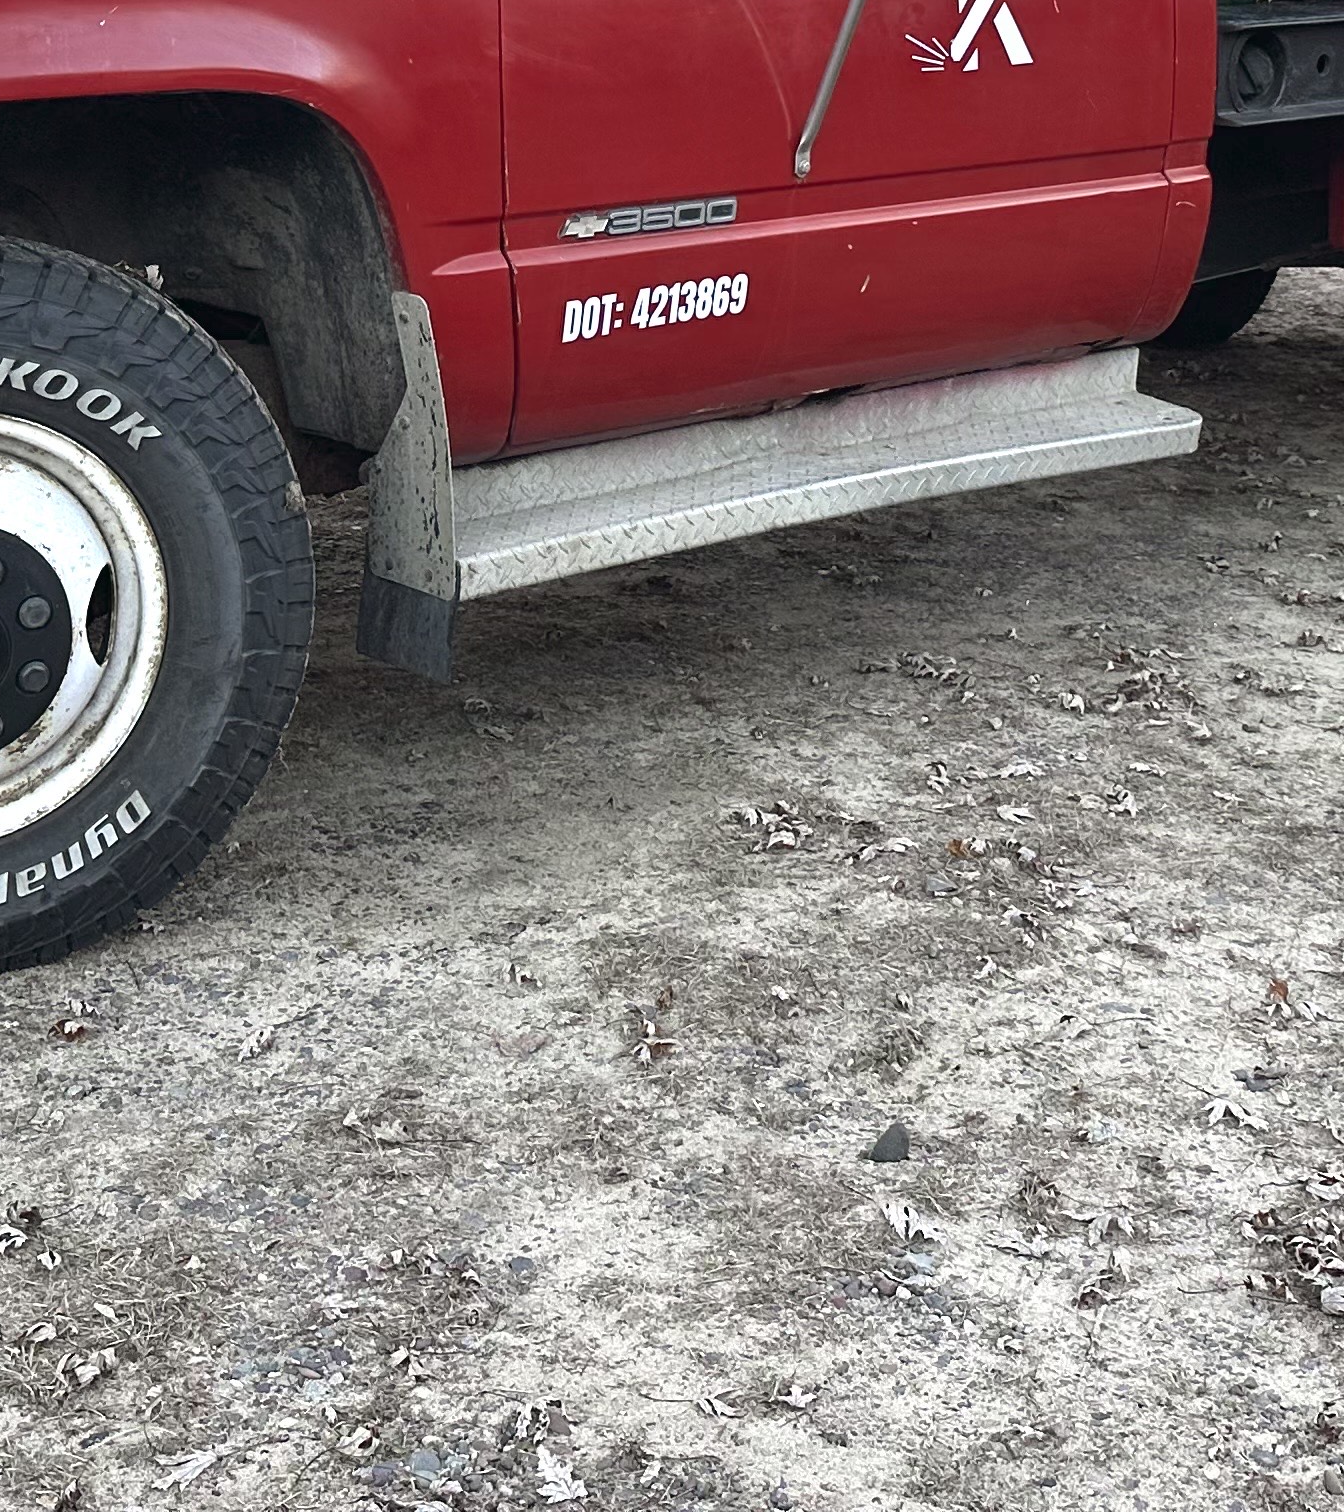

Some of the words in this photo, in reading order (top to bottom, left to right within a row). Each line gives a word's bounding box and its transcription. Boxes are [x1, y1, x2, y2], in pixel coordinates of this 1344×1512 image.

[607, 195, 738, 236] 3500
[561, 293, 624, 344] DOT:
[630, 273, 749, 330] 4213869
